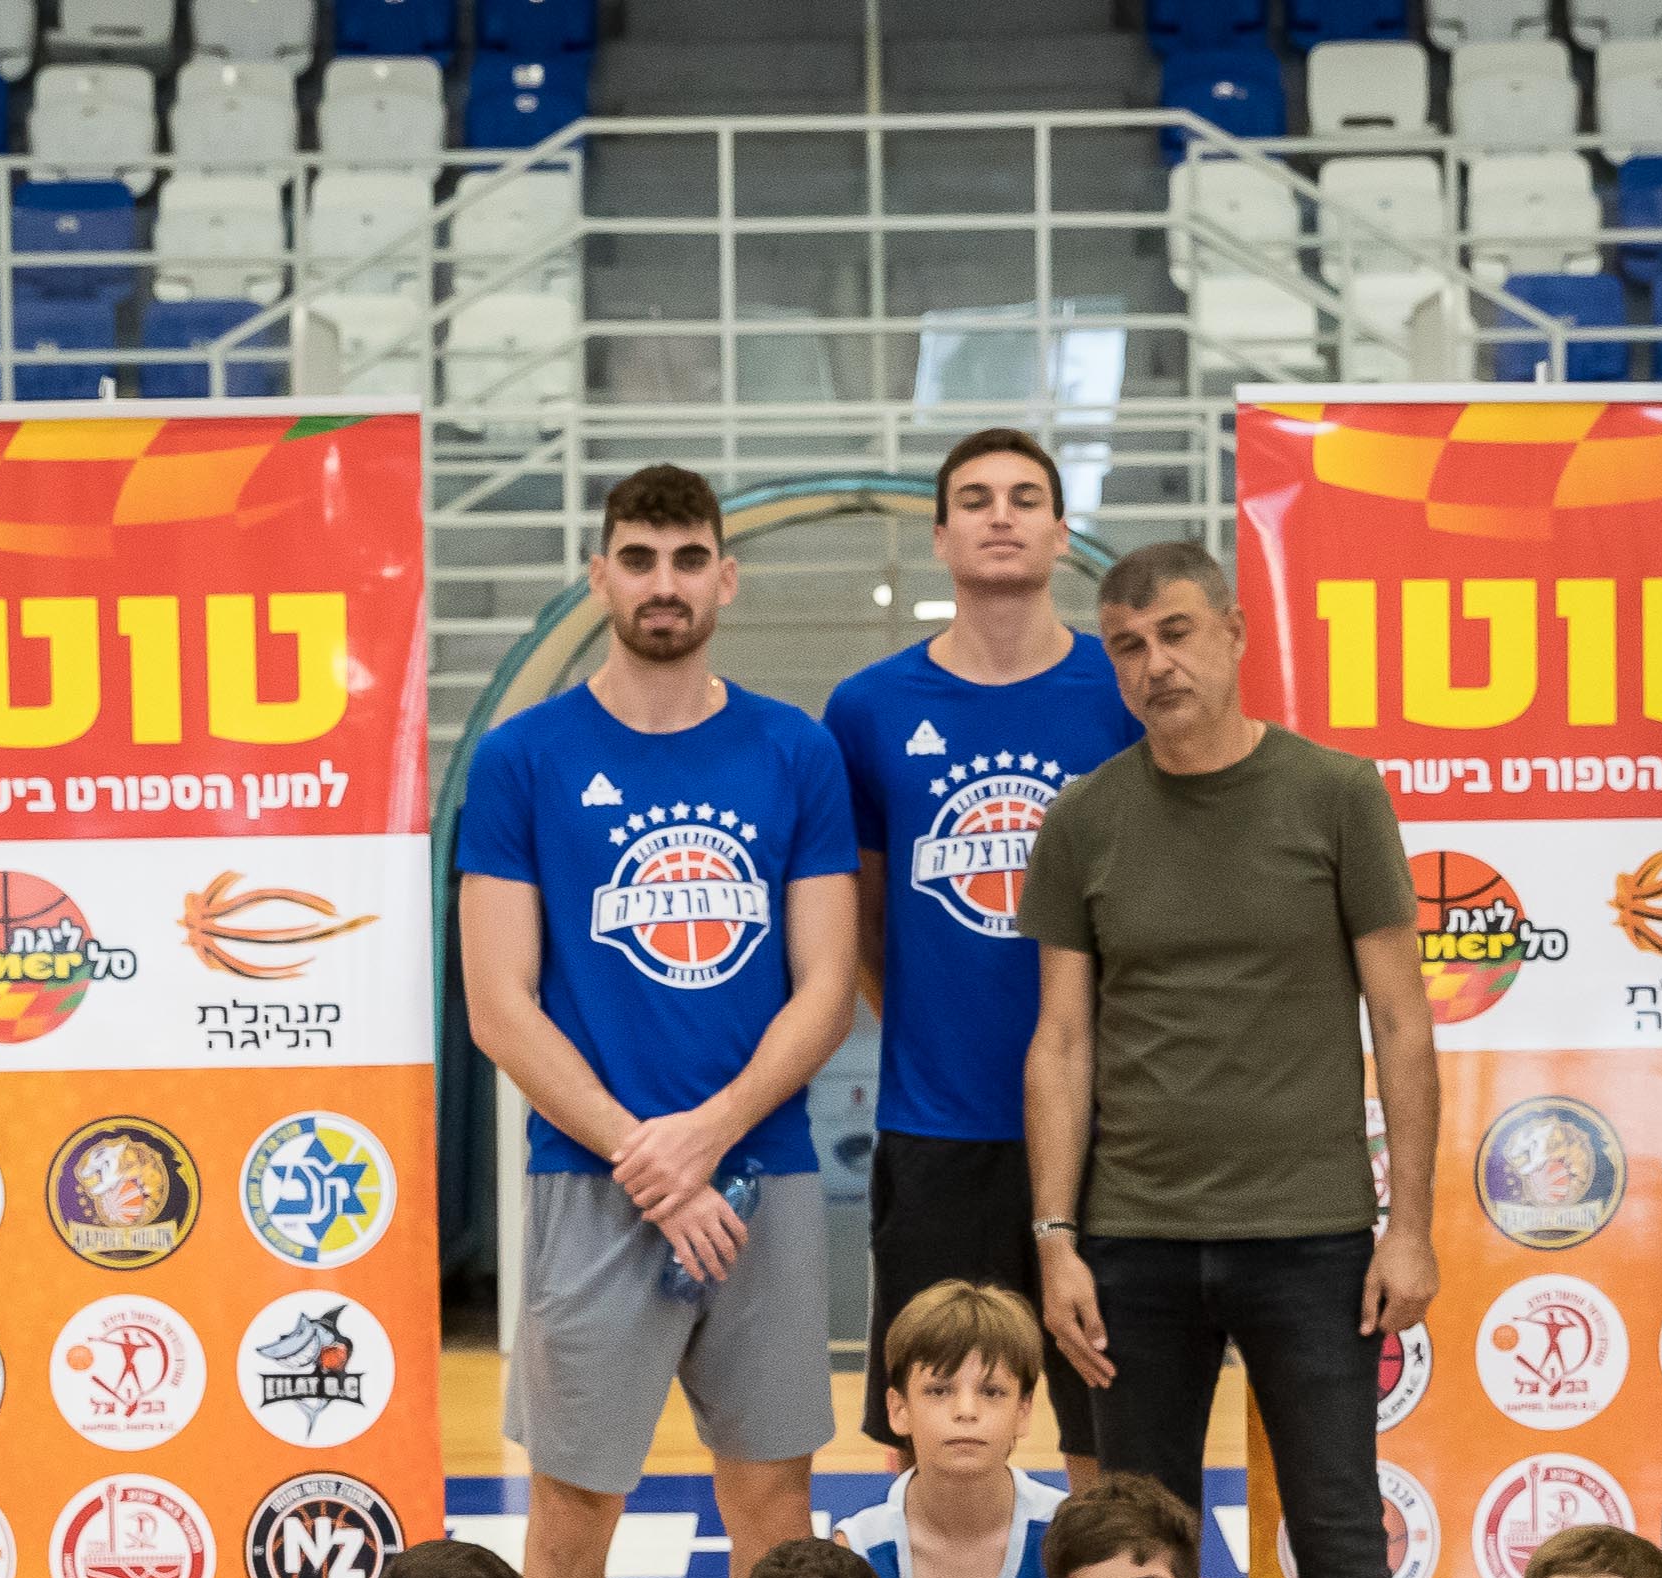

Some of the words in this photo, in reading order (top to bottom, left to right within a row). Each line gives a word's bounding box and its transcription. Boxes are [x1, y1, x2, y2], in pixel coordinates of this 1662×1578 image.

[65, 770, 230, 814] הספורט
[241, 759, 349, 819] למען
[1374, 758, 1491, 795] בישר
[615, 887, 712, 922] הרצליה
[721, 887, 759, 917] בני
[1446, 899, 1517, 931] ליגת
[11, 918, 84, 954] ליגת
[1520, 920, 1569, 962] סל
[87, 931, 137, 980] סל
[197, 999, 341, 1026] מנהלת
[207, 1022, 334, 1051] הליגה
